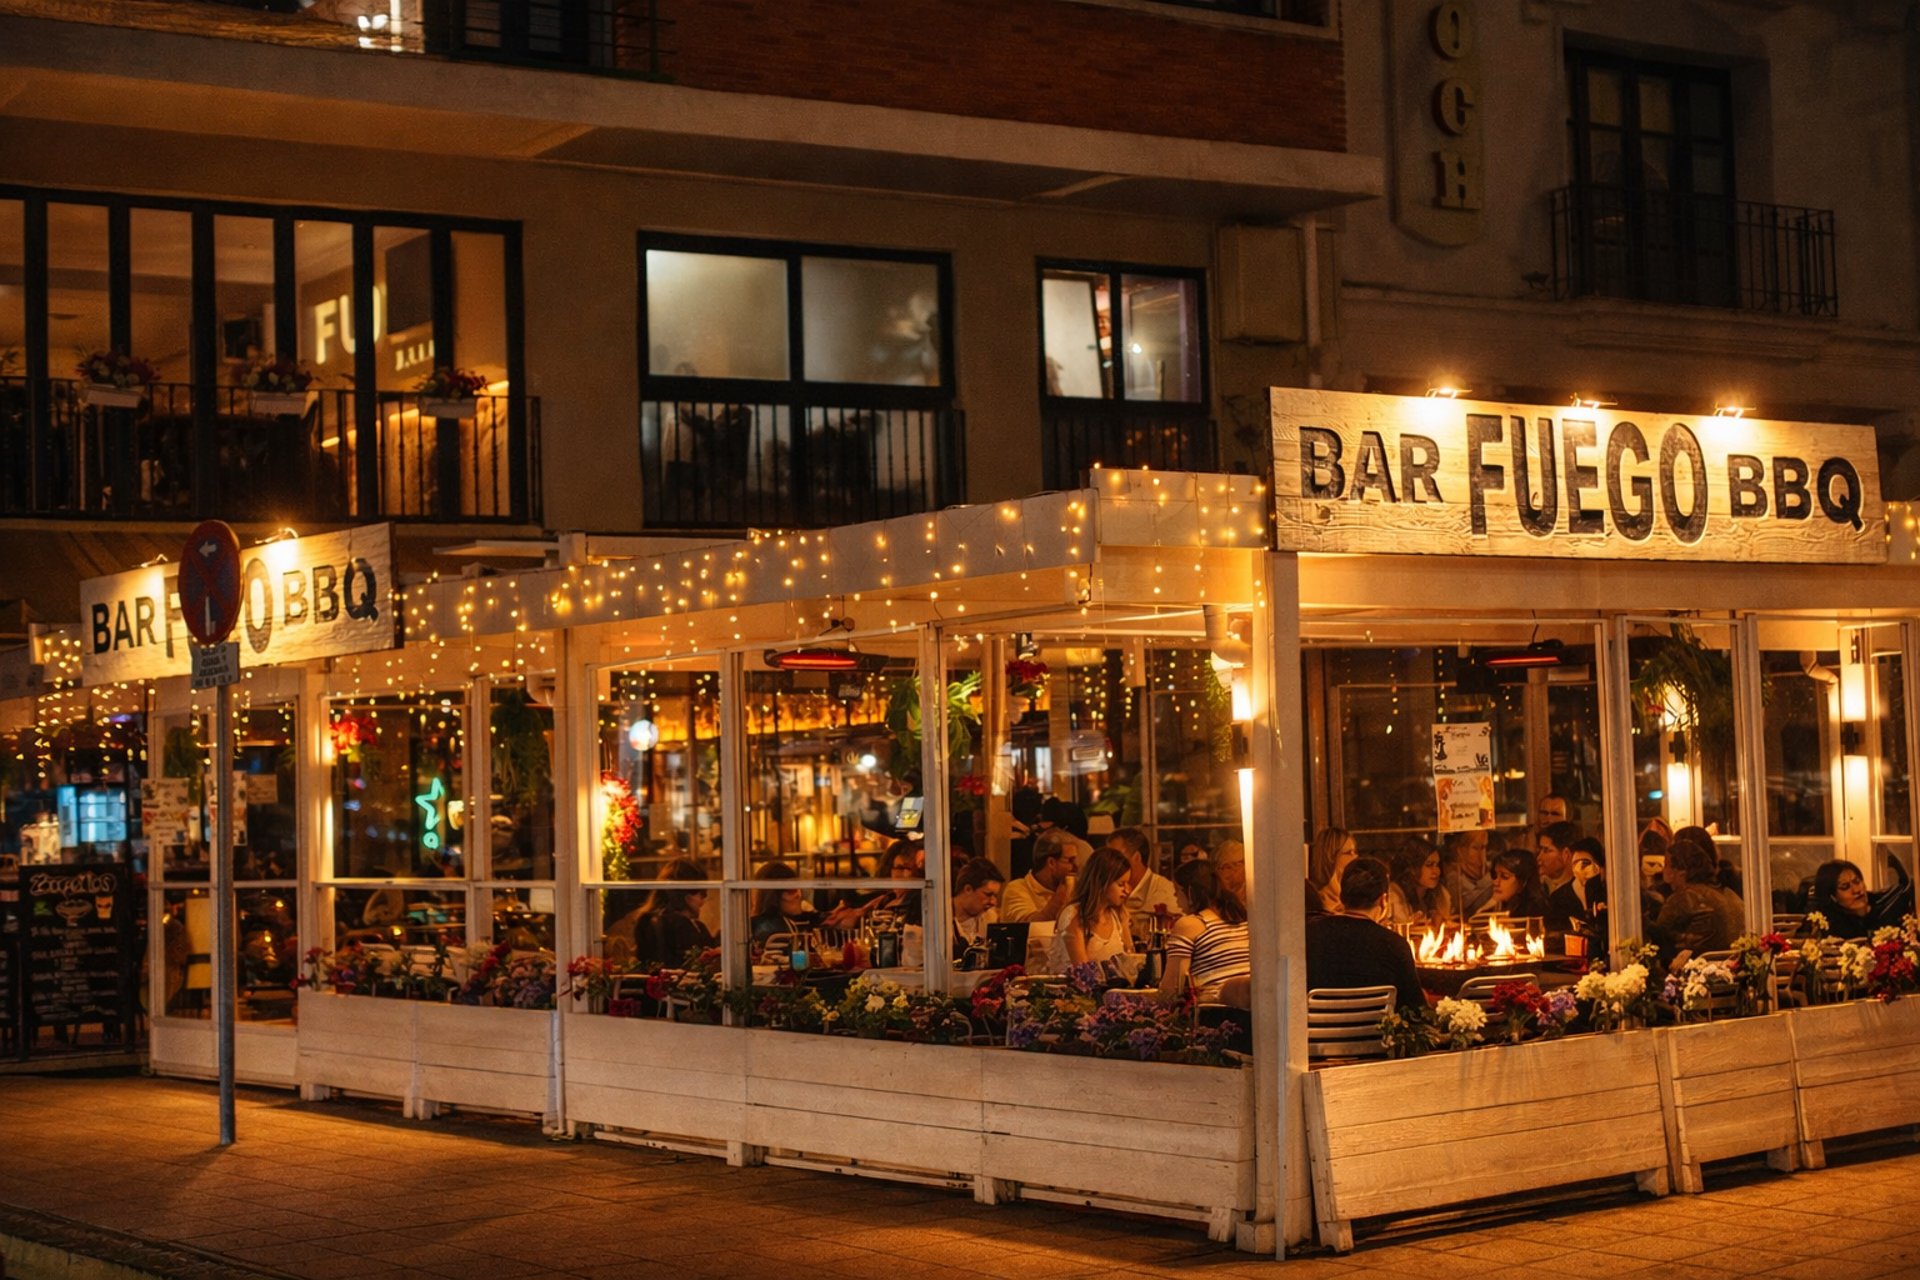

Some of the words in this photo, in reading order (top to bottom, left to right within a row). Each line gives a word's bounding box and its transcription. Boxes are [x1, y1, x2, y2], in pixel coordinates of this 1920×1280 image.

[1300, 425, 1444, 504] BAR
[1466, 412, 1709, 546] FUEGO
[1727, 453, 1865, 534] BBQ
[91, 596, 157, 655] BAR
[283, 557, 379, 626] BBQ
